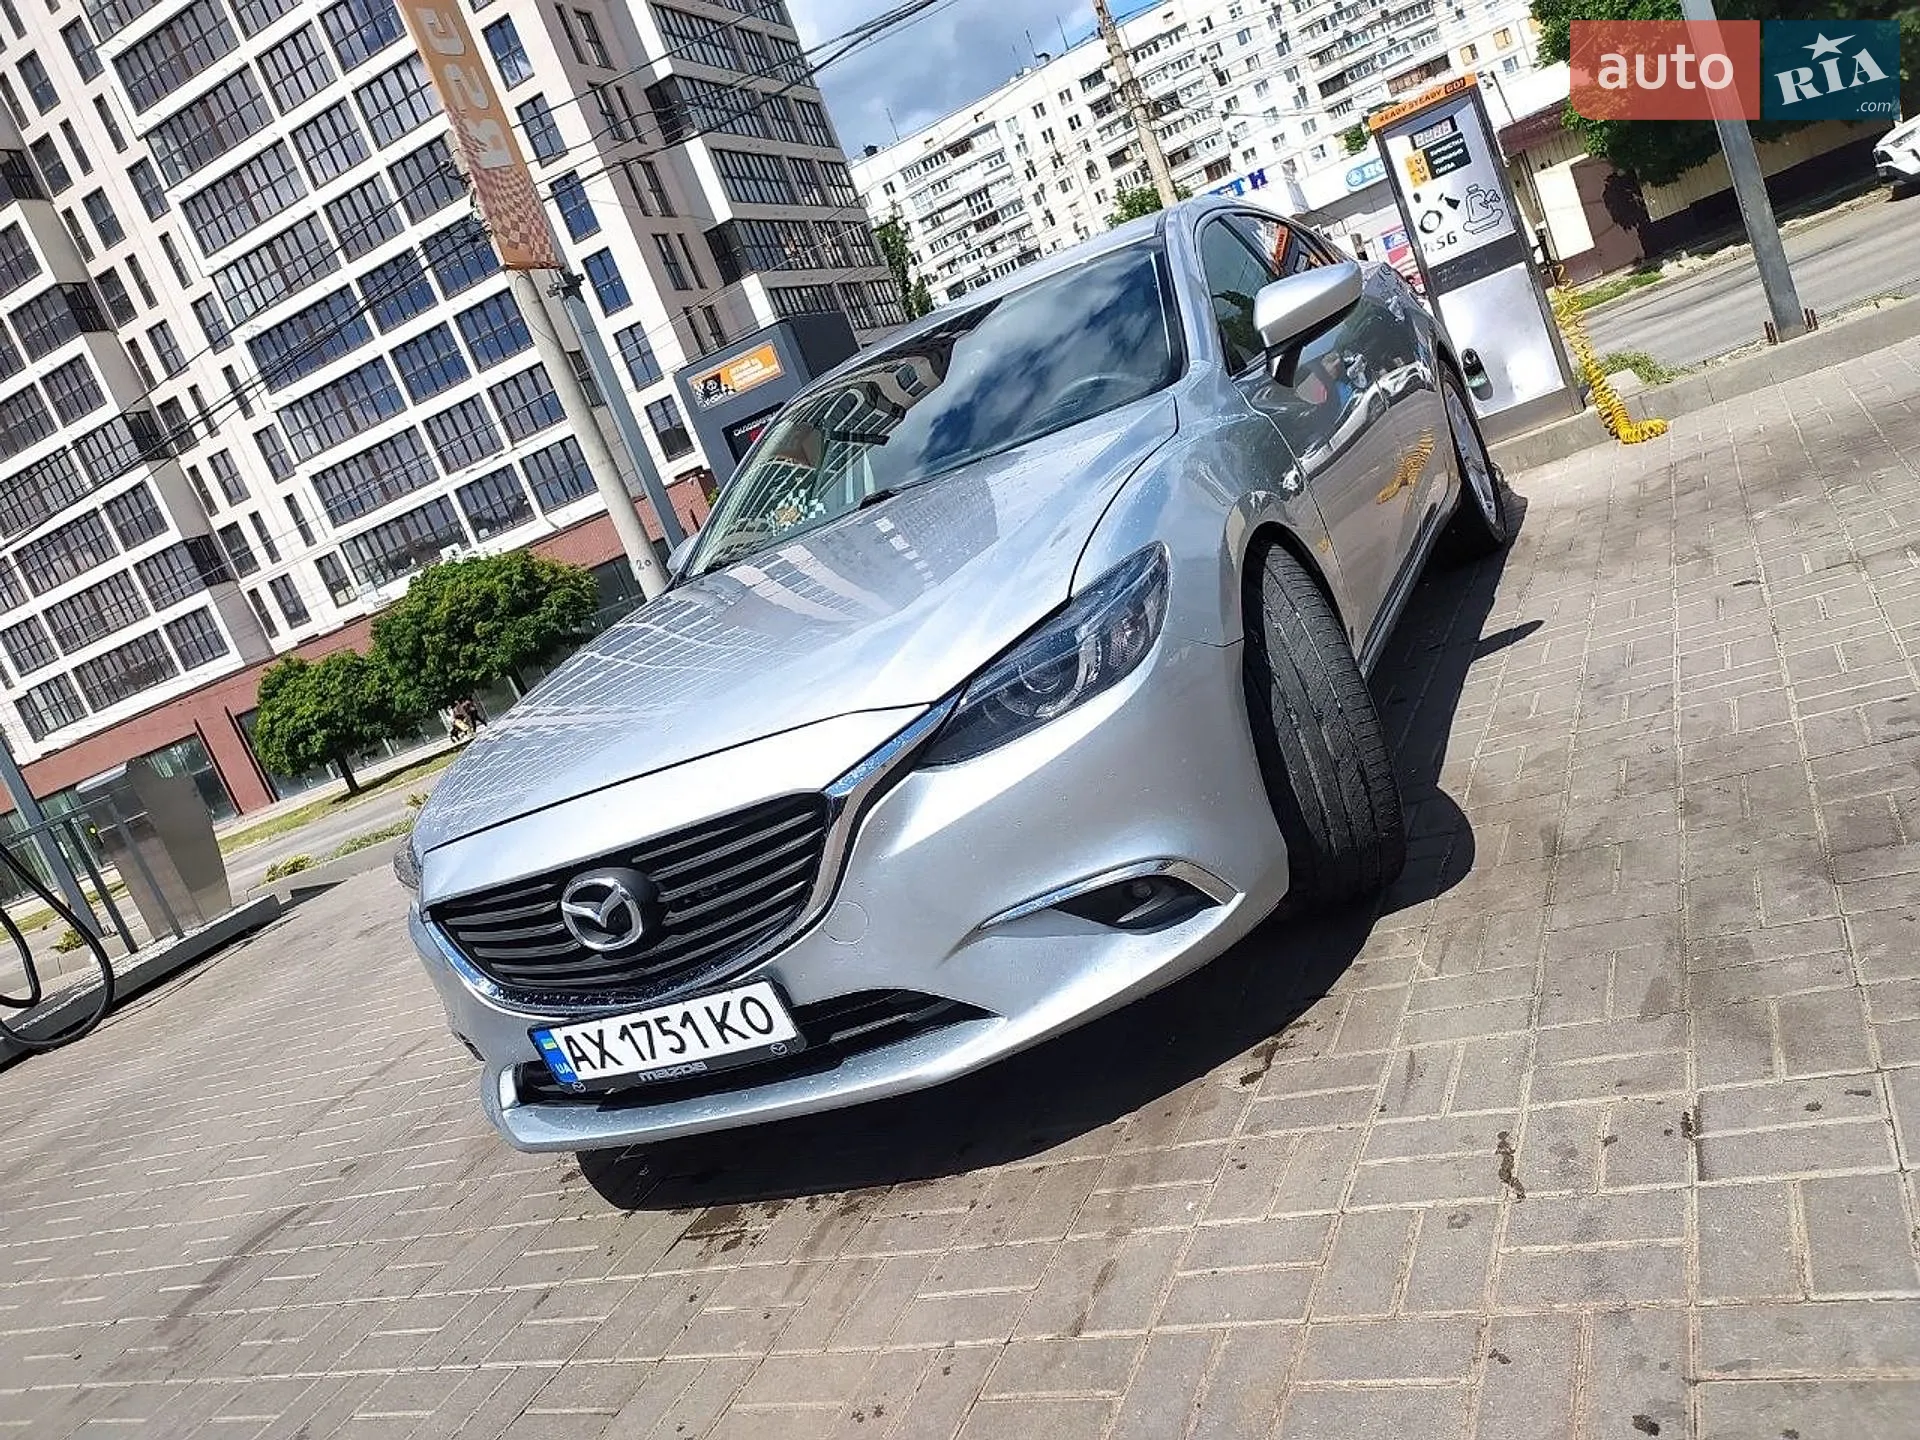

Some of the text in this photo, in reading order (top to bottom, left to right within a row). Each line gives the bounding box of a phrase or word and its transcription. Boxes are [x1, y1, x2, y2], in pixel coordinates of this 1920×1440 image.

[1379, 106, 1407, 122] READY
[1408, 89, 1443, 110] STEADY
[563, 995, 775, 1073] AX 1751 KO
[556, 1062, 572, 1076] UA
